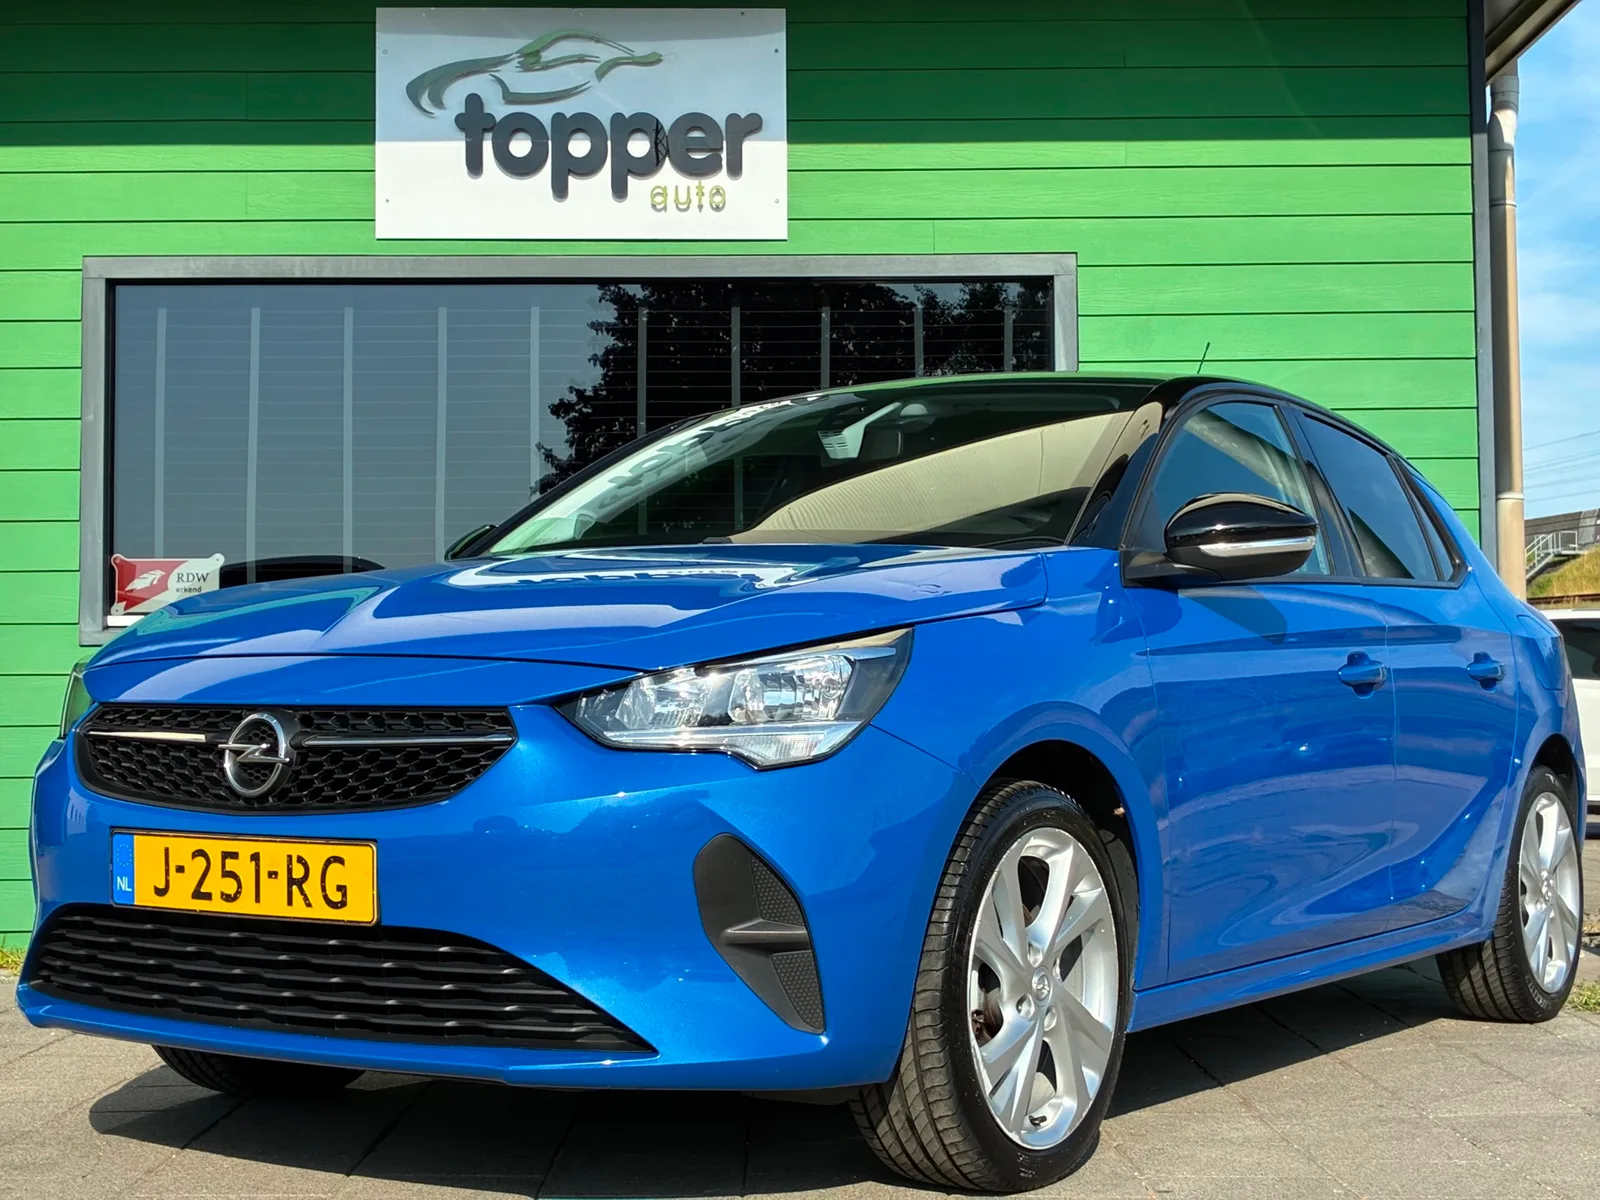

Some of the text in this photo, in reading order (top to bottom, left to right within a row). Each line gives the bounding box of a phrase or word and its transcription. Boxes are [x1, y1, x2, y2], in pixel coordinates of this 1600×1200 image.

[455, 93, 763, 202] topper
[650, 181, 726, 212] auto
[176, 572, 209, 583] RDW
[117, 876, 132, 892] NL
[153, 846, 348, 910] J-251-RG
